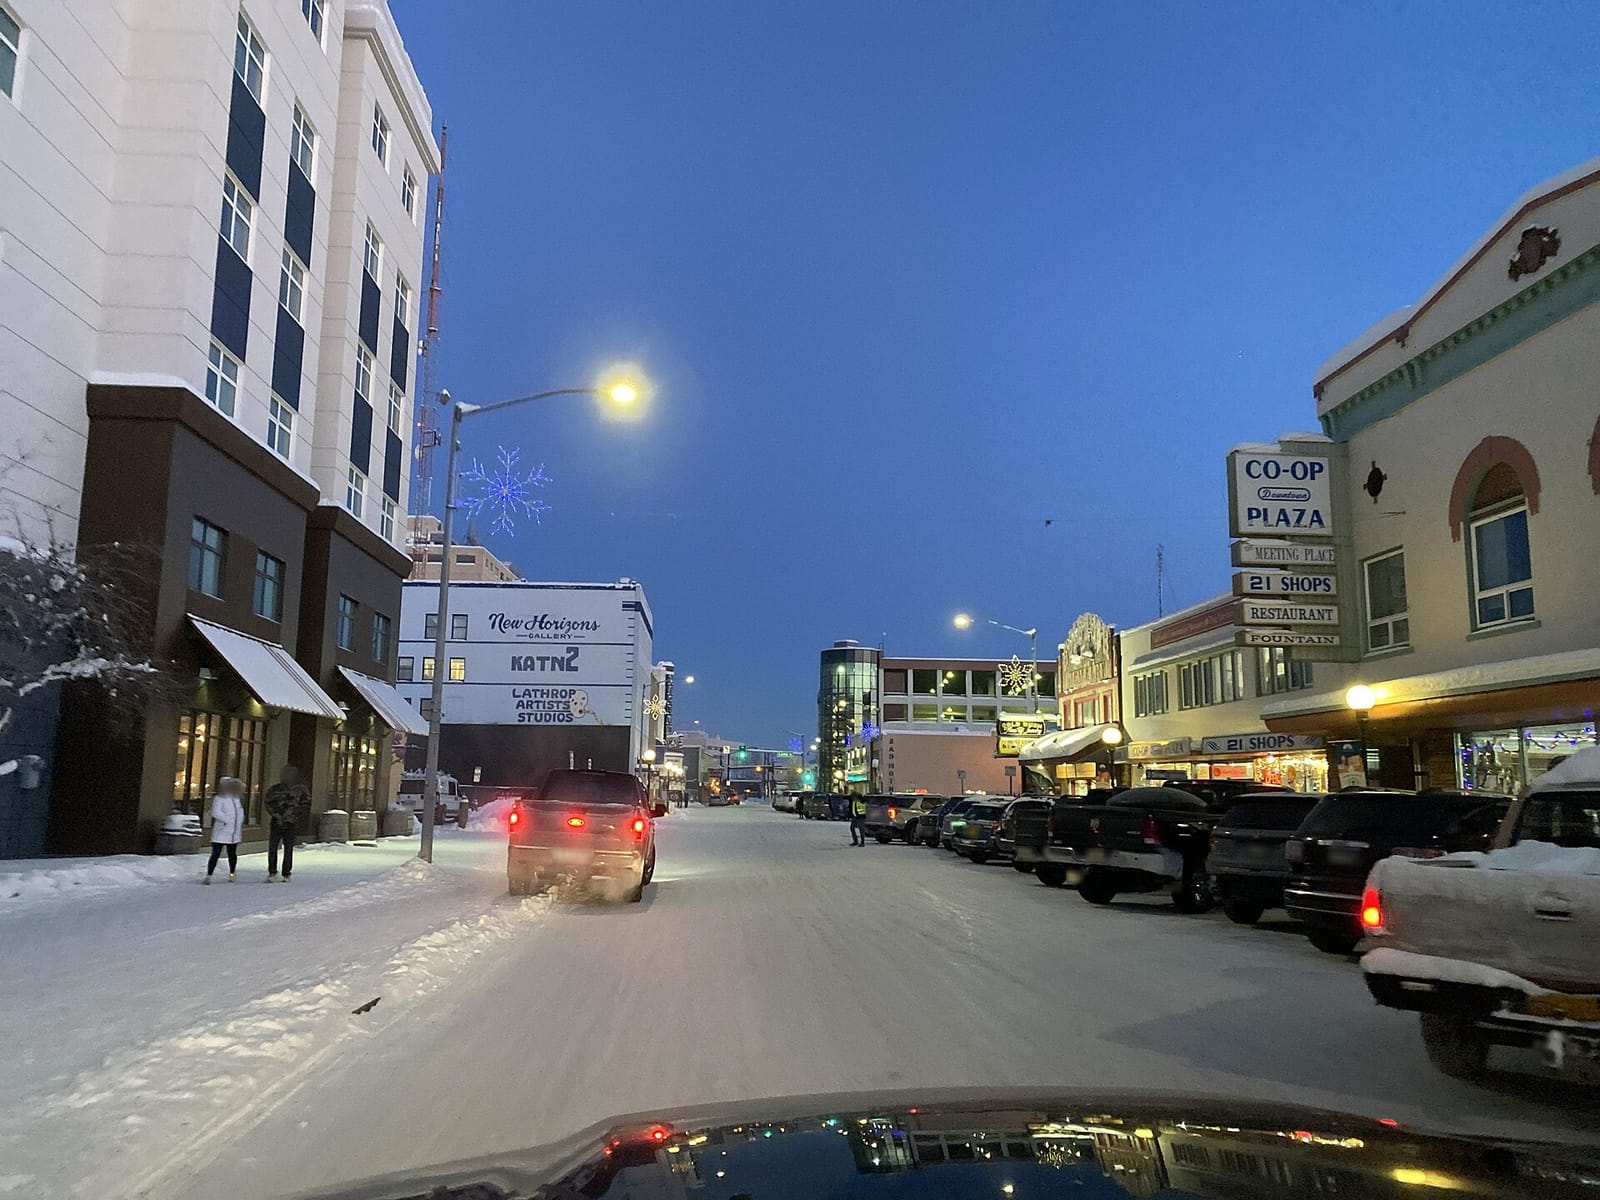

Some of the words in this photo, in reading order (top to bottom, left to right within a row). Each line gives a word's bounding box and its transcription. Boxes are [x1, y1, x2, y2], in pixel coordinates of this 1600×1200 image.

[1245, 459, 1325, 481] CO-OP
[1261, 488, 1309, 499] Downtown
[1247, 507, 1326, 529] PLAZA
[1255, 547, 1299, 561] MEETING
[1304, 548, 1336, 562] PLACE
[1250, 576, 1271, 590] 21
[1281, 577, 1331, 592] SHOPS
[1251, 607, 1334, 620] RESTAURANT
[488, 613, 523, 634] New
[525, 614, 600, 634] Horizons
[1251, 635, 1335, 644] FOUNTAIN
[511, 646, 579, 672] KATN2
[512, 688, 577, 699] LATHROP
[516, 700, 571, 710] ARTISTS
[517, 712, 574, 723] STUDIOS
[1227, 739, 1243, 750] 21
[1250, 735, 1295, 750] SHOPS
